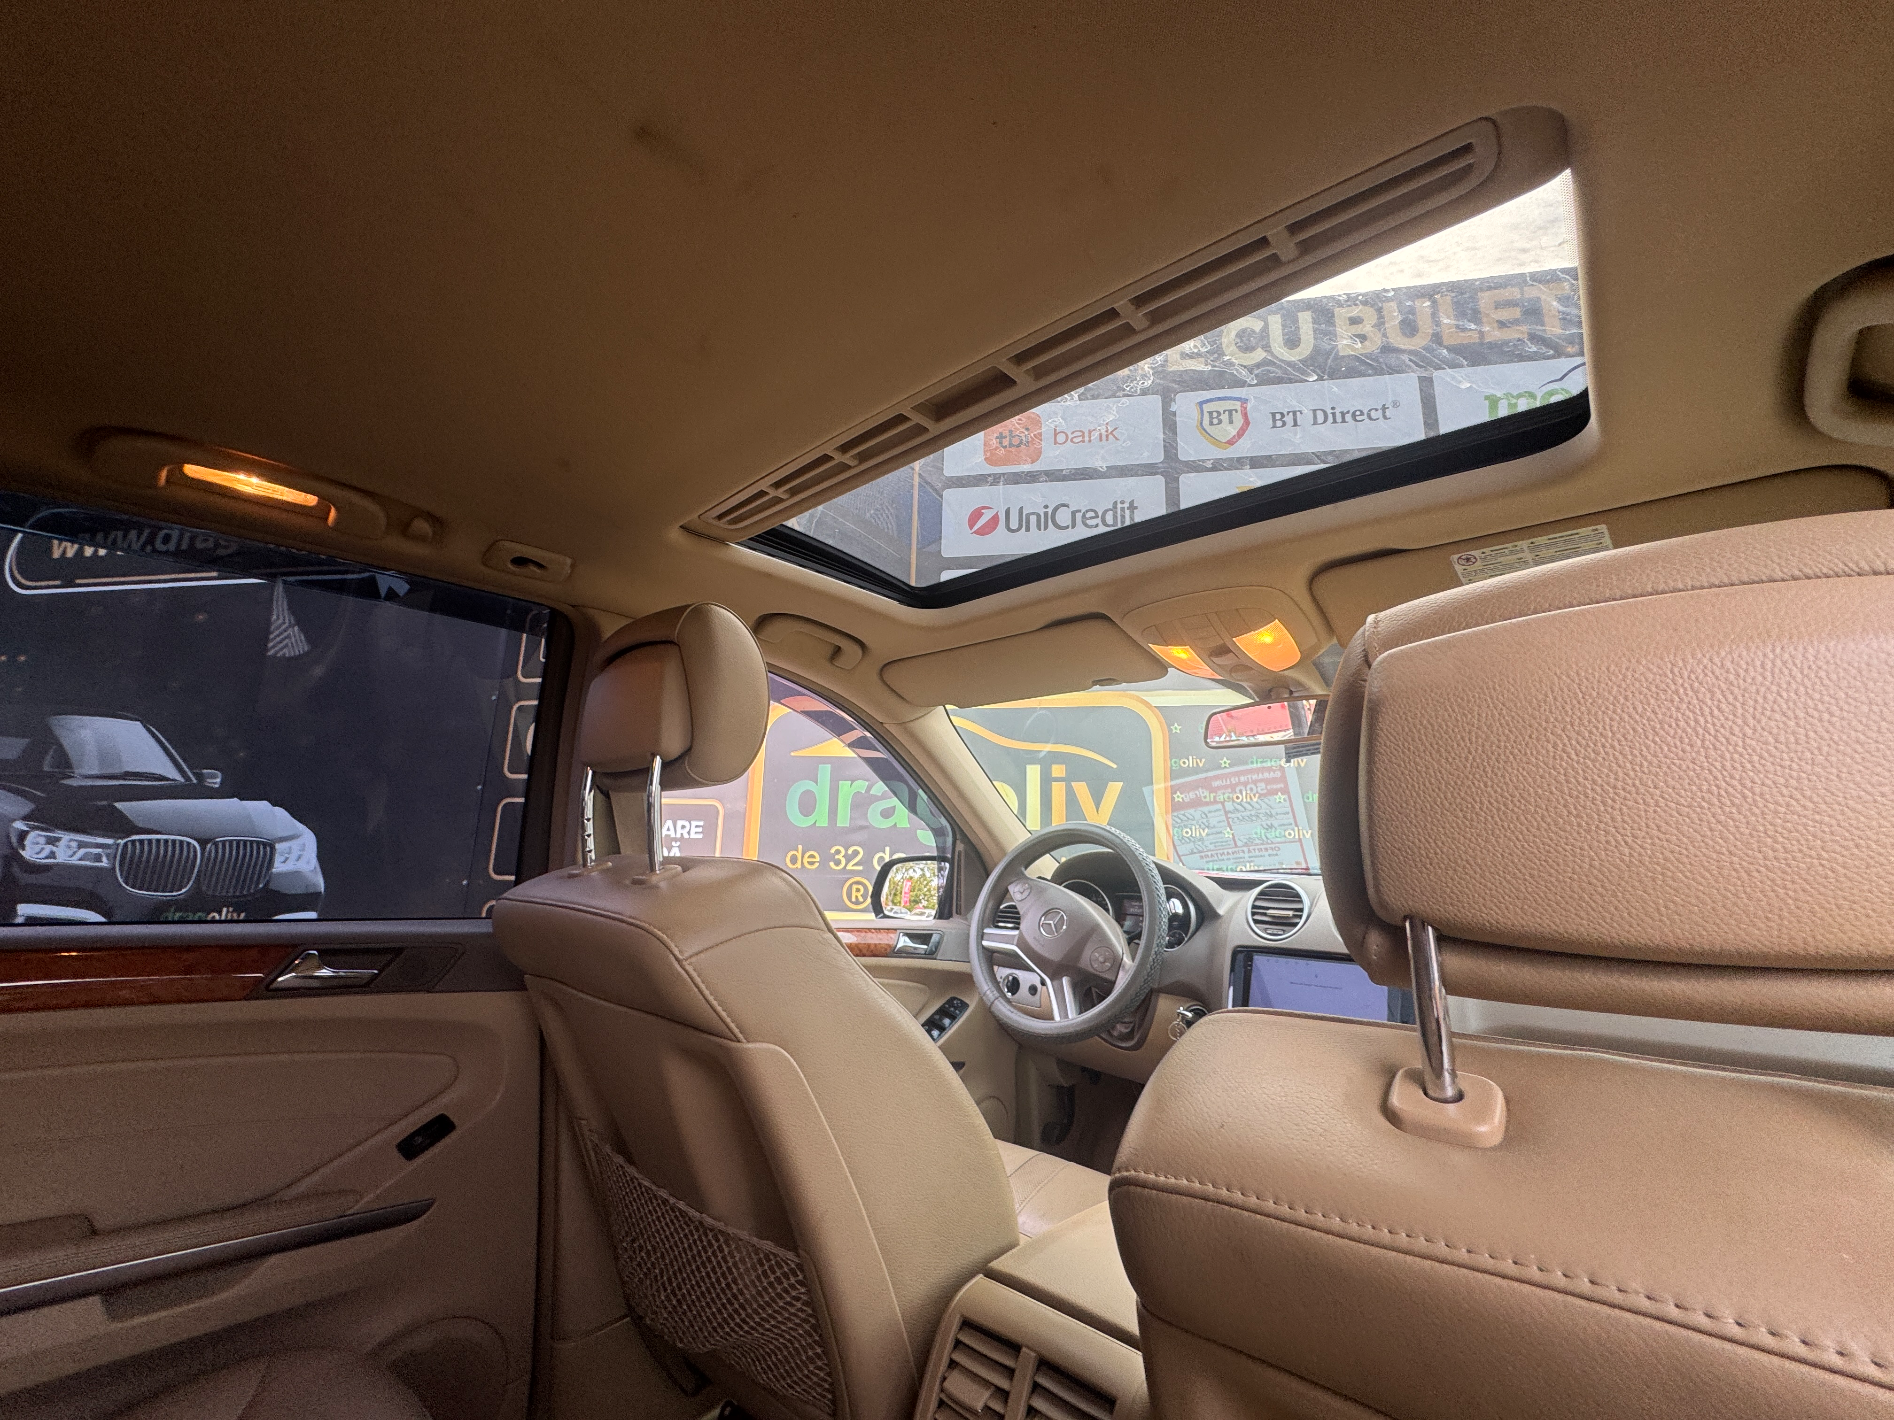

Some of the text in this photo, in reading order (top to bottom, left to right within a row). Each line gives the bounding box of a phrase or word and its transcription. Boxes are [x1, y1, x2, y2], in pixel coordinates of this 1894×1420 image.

[1222, 311, 1314, 367] CU
[1337, 283, 1569, 357] BULET
[1206, 408, 1238, 427] BT
[1270, 409, 1303, 430] BT
[995, 422, 1120, 450] tbi bank
[1004, 499, 1139, 534] UniCredit
[785, 845, 820, 870] de
[829, 845, 863, 870] 32
